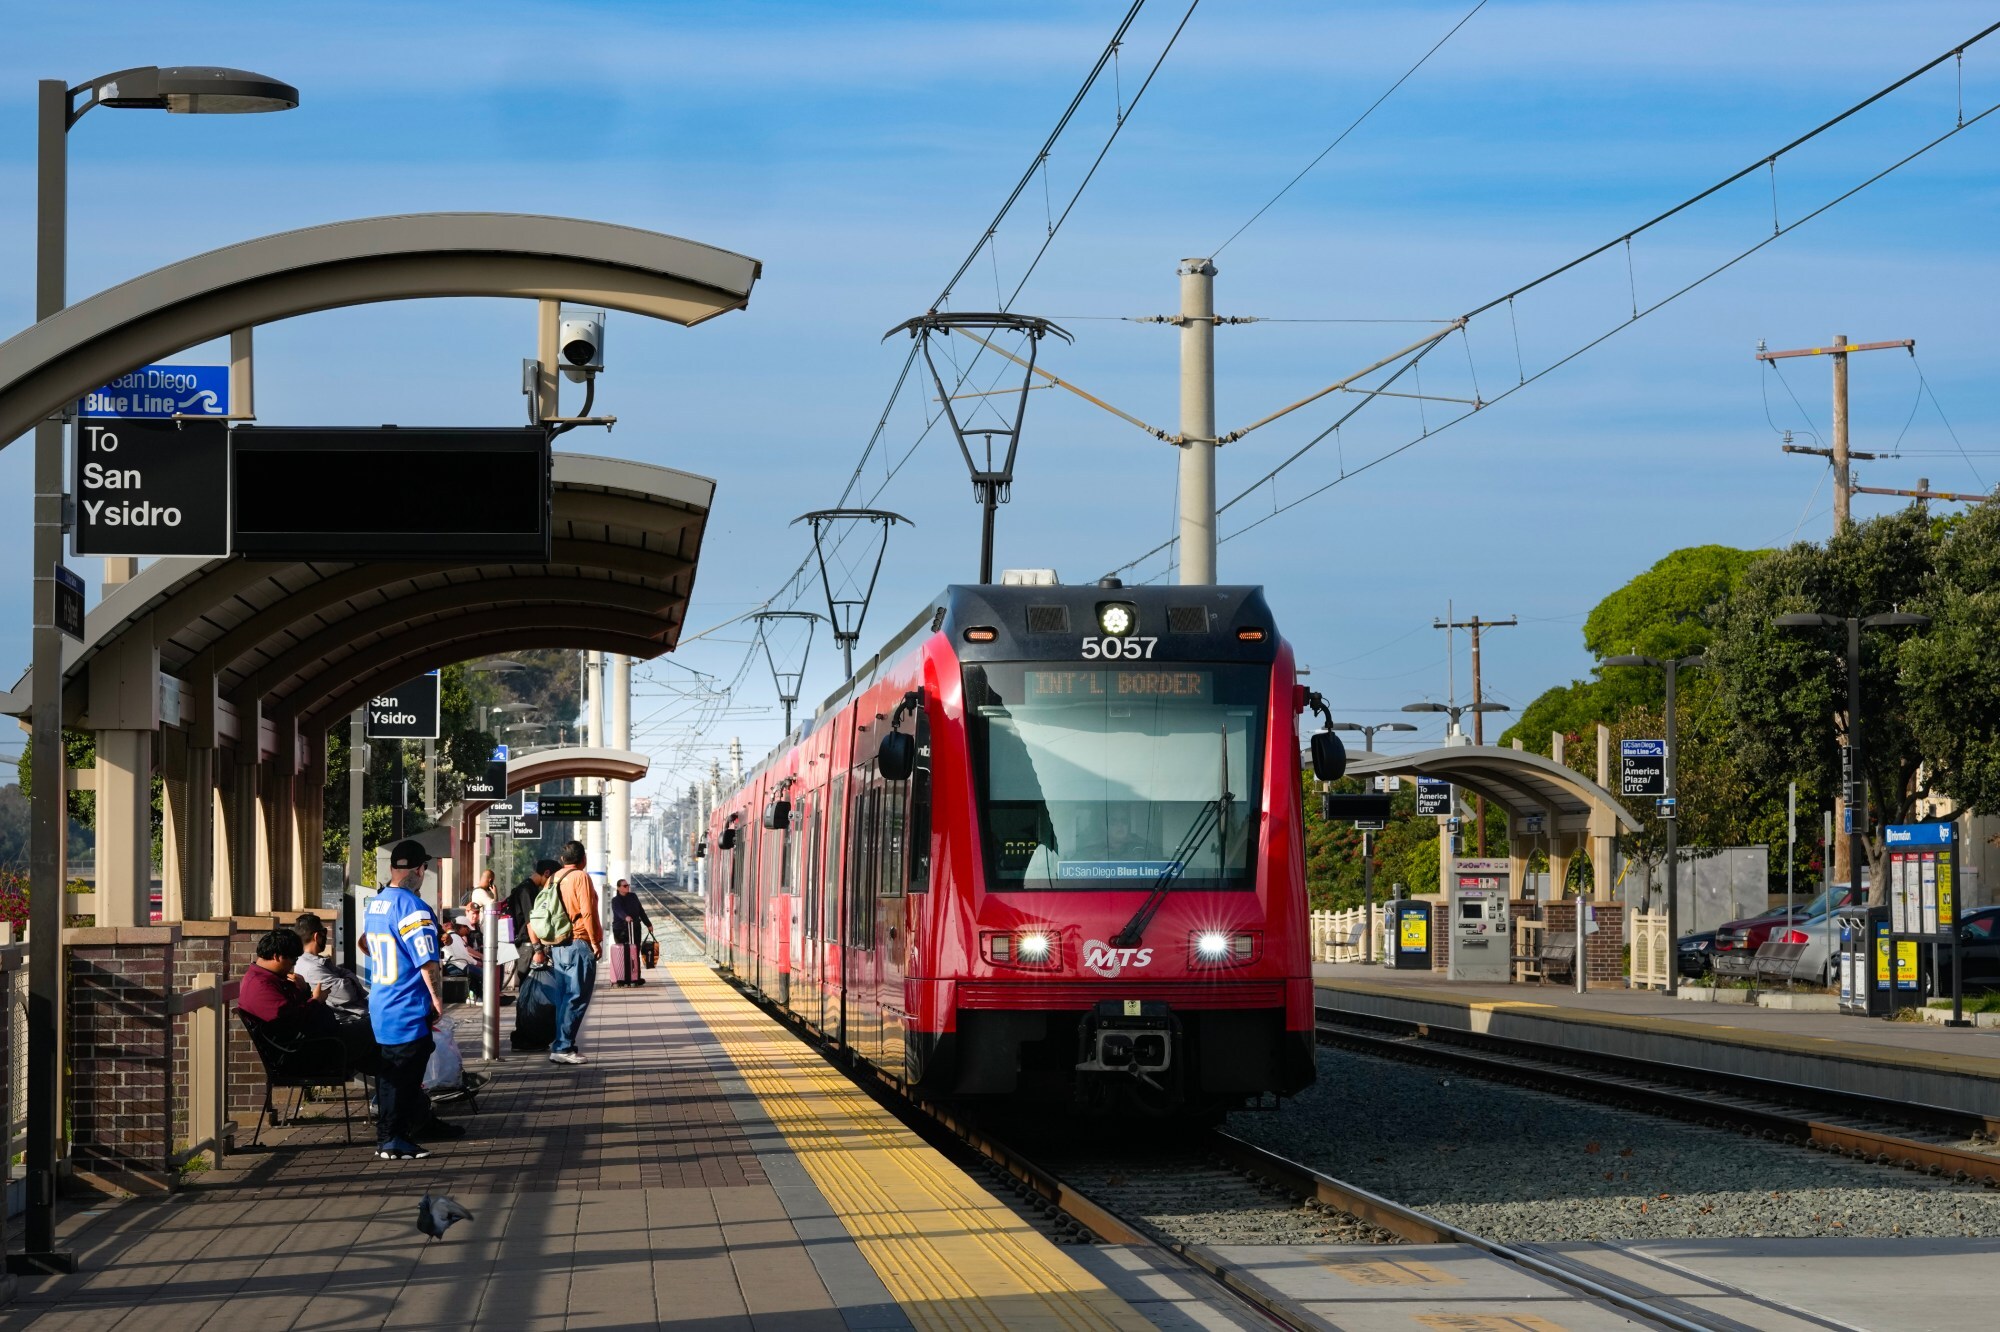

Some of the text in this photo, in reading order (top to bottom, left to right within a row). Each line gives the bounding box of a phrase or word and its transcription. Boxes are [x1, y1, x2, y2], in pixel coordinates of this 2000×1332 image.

[148, 370, 197, 394] Diego
[85, 393, 175, 413] Blue Line
[85, 426, 119, 452] To
[83, 462, 142, 489] San
[82, 500, 182, 527] Ysidro
[1081, 636, 1158, 660] 5057
[1035, 672, 1201, 694] INT'L BORDER
[370, 711, 417, 725] Ysidro
[1624, 758, 1635, 767] To
[1624, 767, 1660, 775] America
[466, 784, 494, 792] Ysidro
[1624, 776, 1652, 784] Plaza/
[1624, 784, 1644, 792] UTC
[1419, 785, 1428, 793] To
[589, 801, 595, 809] 2
[1062, 866, 1160, 878] UC San Diego Blue Line
[413, 934, 435, 957] 80
[1084, 948, 1154, 967] MTS
